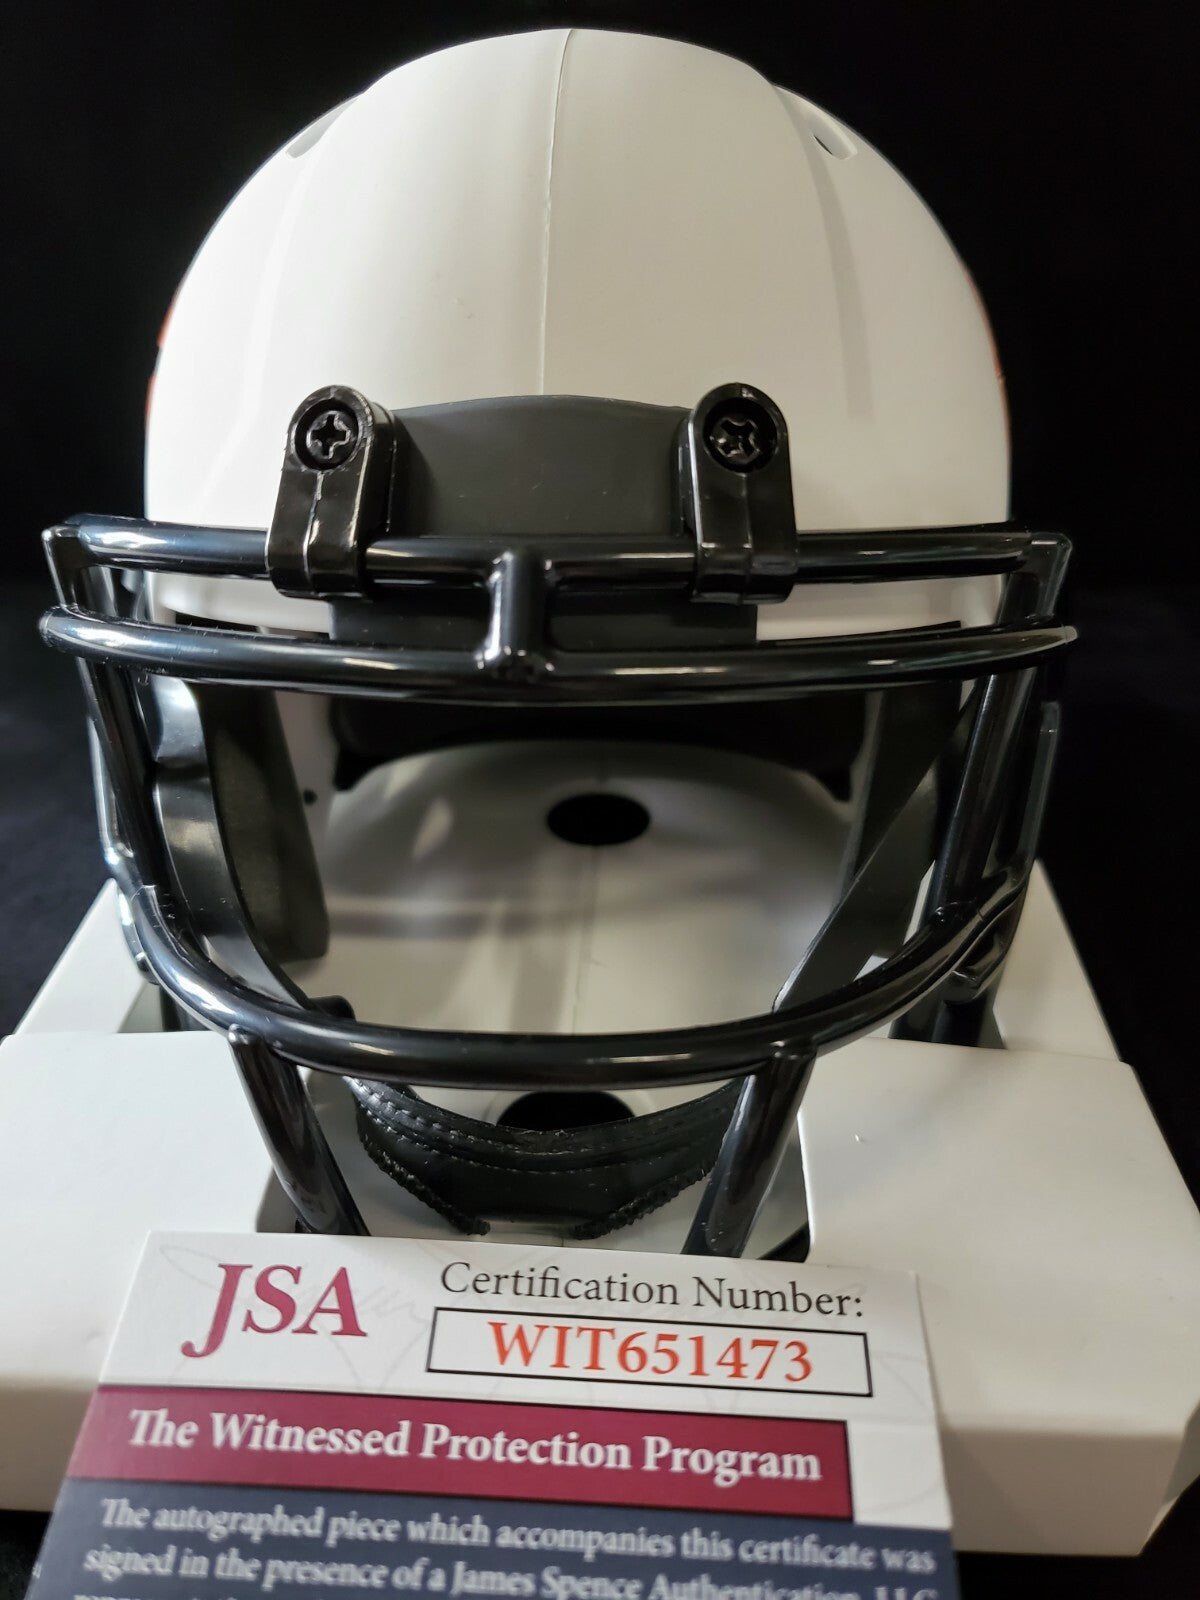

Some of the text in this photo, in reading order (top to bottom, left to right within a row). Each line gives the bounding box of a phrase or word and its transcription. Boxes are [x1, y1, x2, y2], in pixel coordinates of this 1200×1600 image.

[180, 1263, 368, 1358] JSA
[441, 1261, 863, 1318] Certification Number:
[488, 1321, 813, 1383] WIT651473
[128, 1408, 822, 1488] The Witnessed Protection Program
[83, 1544, 177, 1582] signed
[179, 1547, 209, 1578] in
[214, 1547, 262, 1581] the
[262, 1556, 390, 1592] presence
[392, 1556, 430, 1591] of
[427, 1570, 446, 1591] a
[102, 1498, 937, 1574] The autographed piece which accompanies this certificate was
